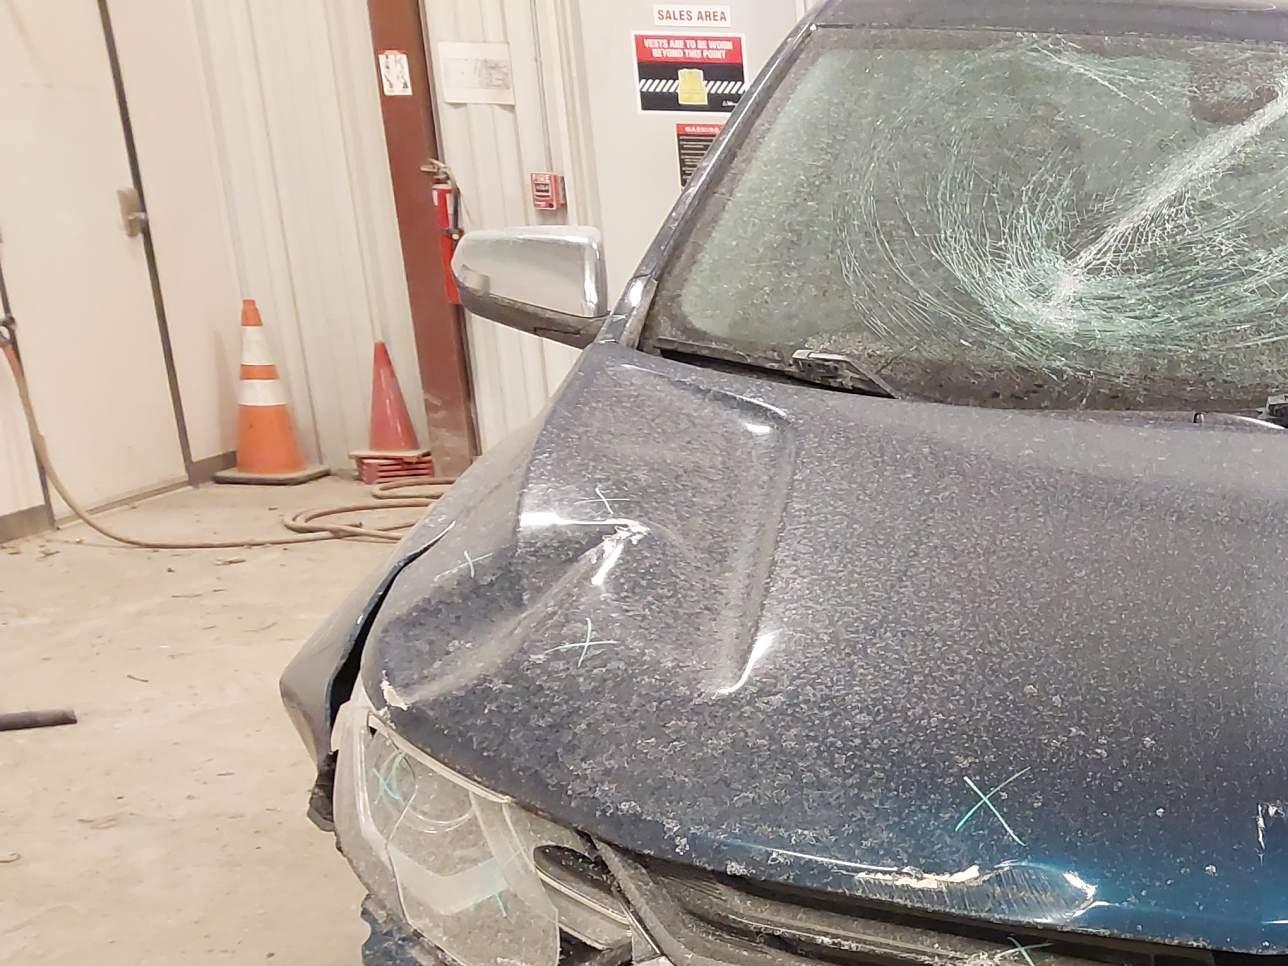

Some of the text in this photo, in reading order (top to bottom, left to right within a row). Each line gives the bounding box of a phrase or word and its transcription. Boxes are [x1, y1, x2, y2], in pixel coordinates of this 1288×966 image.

[657, 9, 727, 22] SALES AREA
[643, 38, 668, 49] VESTS
[669, 39, 685, 49] ARE
[686, 40, 696, 49] TO
[697, 40, 708, 49] BE
[684, 49, 702, 58] THIS
